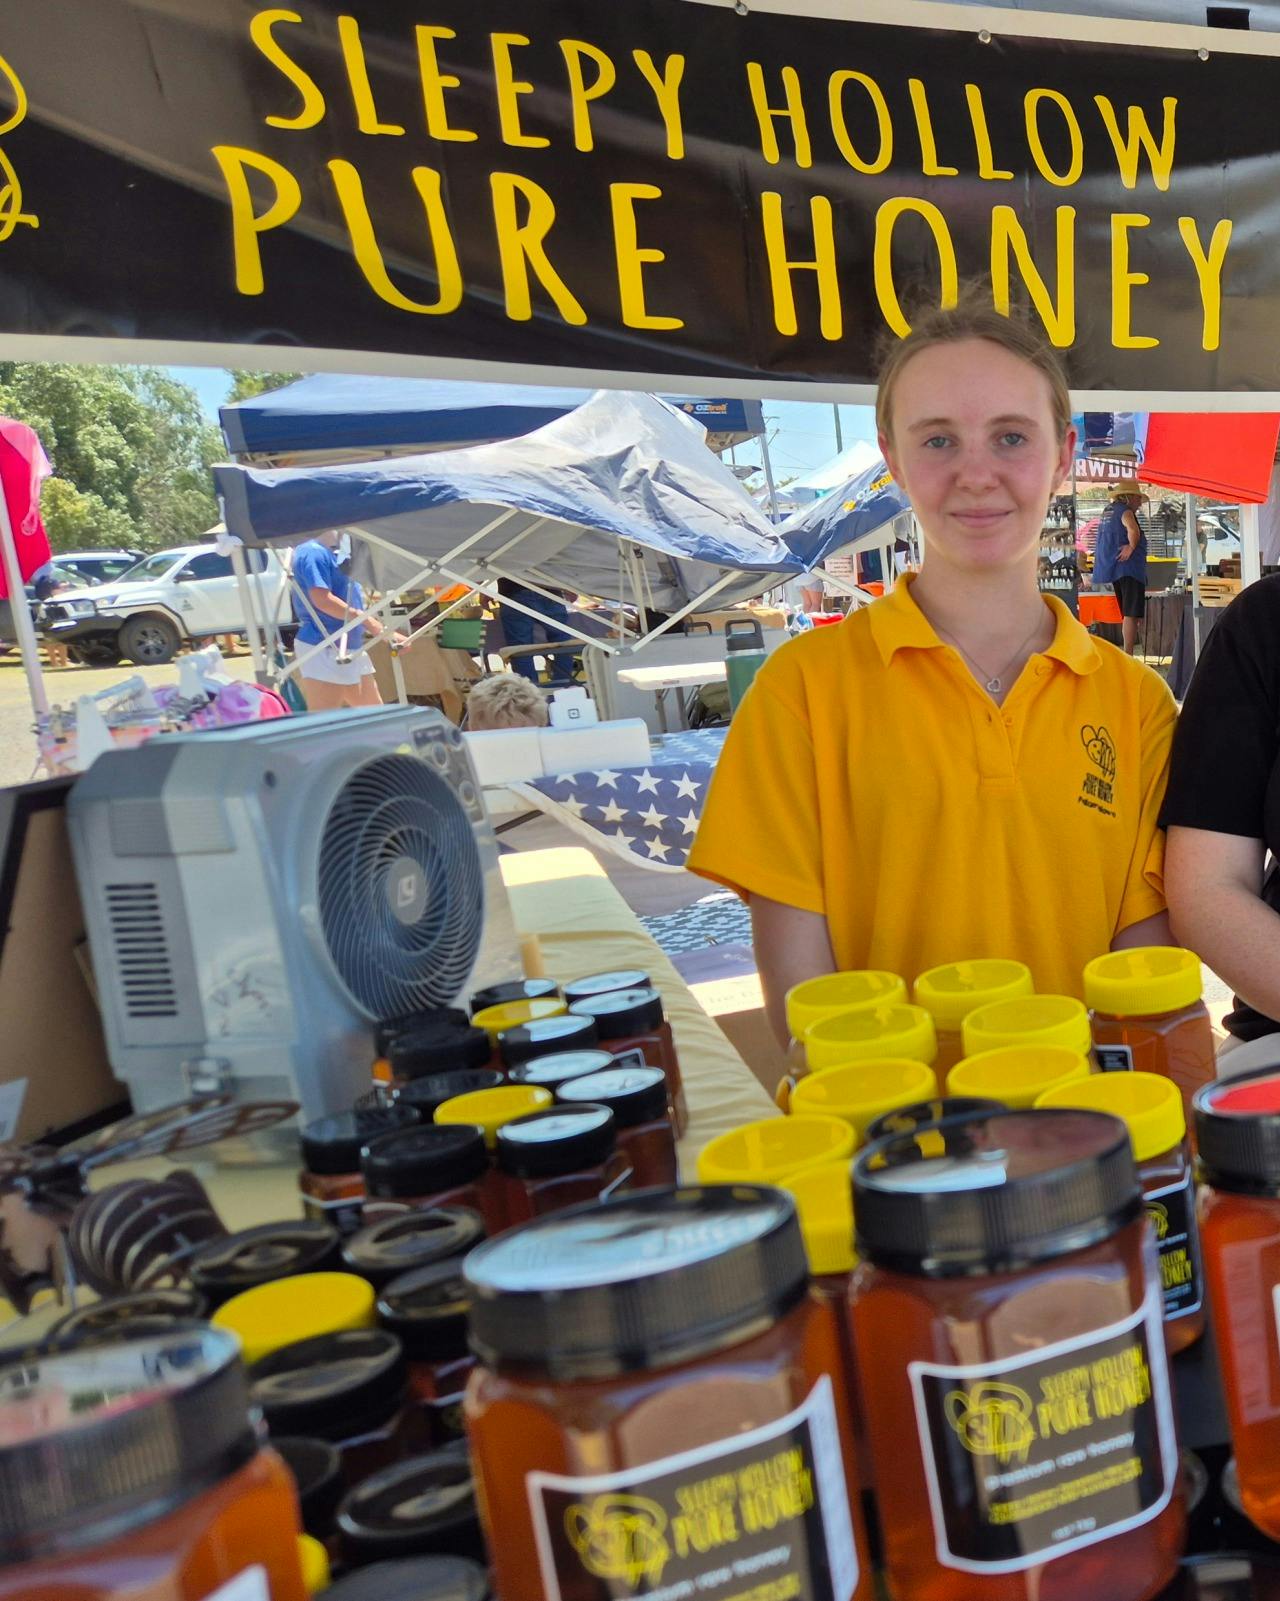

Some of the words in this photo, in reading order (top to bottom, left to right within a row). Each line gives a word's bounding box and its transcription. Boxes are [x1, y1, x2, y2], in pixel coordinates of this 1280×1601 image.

[250, 9, 686, 160] SLEEPY
[746, 62, 1178, 190] HOLLOW
[210, 144, 686, 330] PURE
[761, 191, 1233, 352] HONEY
[1036, 1389, 1093, 1439] PURE
[671, 1502, 741, 1559] PURE
